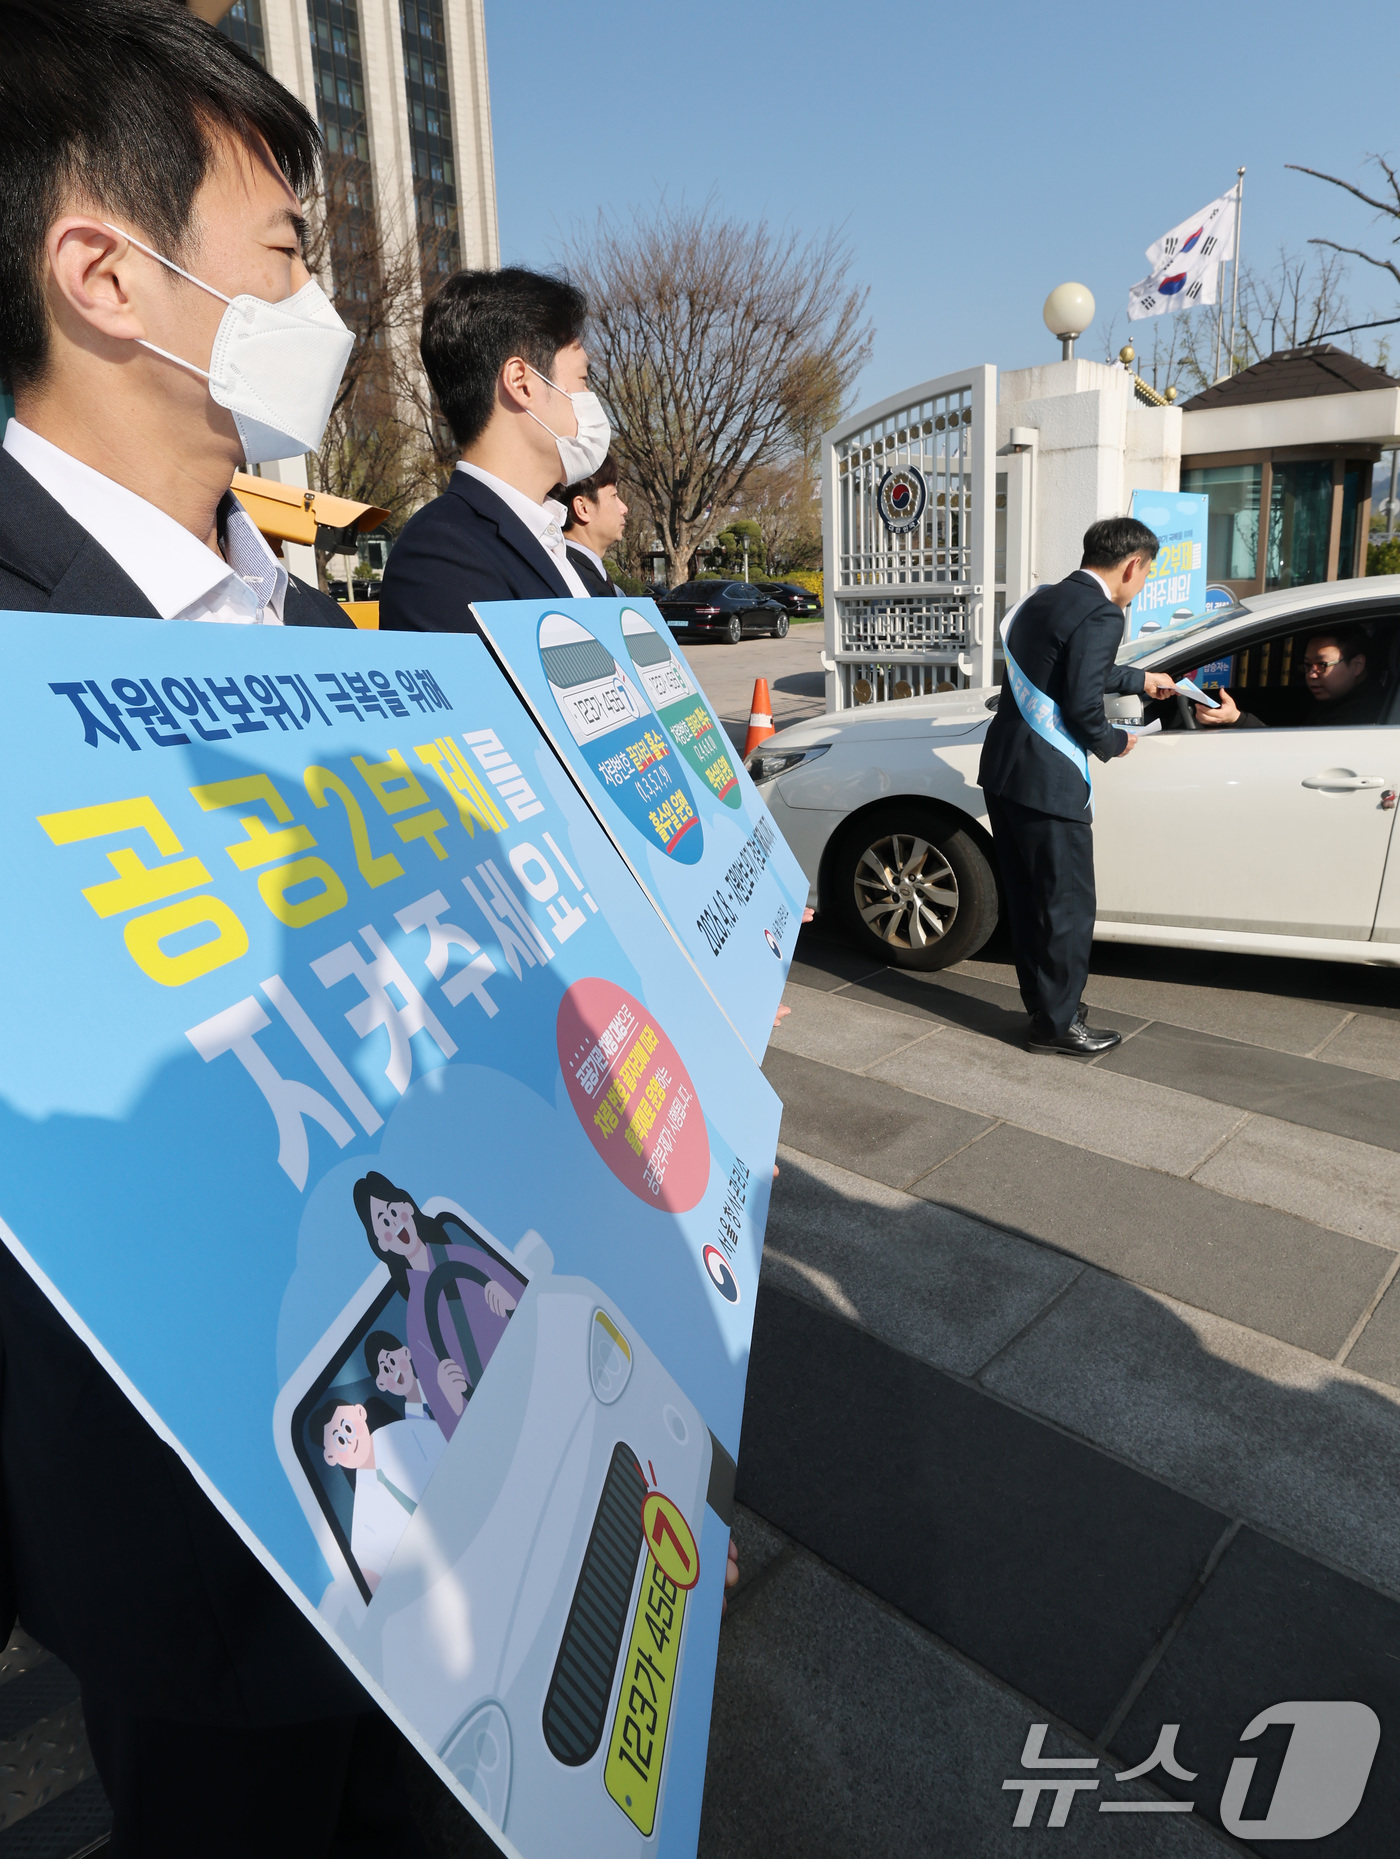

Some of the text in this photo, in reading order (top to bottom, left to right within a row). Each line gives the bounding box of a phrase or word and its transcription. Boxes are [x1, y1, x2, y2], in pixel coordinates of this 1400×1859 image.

[47, 669, 454, 752] 자원안보위기 극복을 위해
[598, 751, 635, 787] 차량번호
[626, 739, 655, 771] 끝자리
[35, 728, 547, 988] 공공2부제를
[648, 788, 693, 843] 홀수일 운행
[184, 831, 600, 1194] 지켜주세요!
[575, 1003, 635, 1095] 공공기관 차량 대상으로
[593, 1023, 660, 1140] 차량 번호 끝자리에 따라
[624, 1065, 672, 1157] 홀짝제로 운영하는
[643, 1124, 676, 1195] 공공2부제가
[717, 1156, 750, 1259] 서울청사관리소
[618, 1646, 666, 1783] 123가
